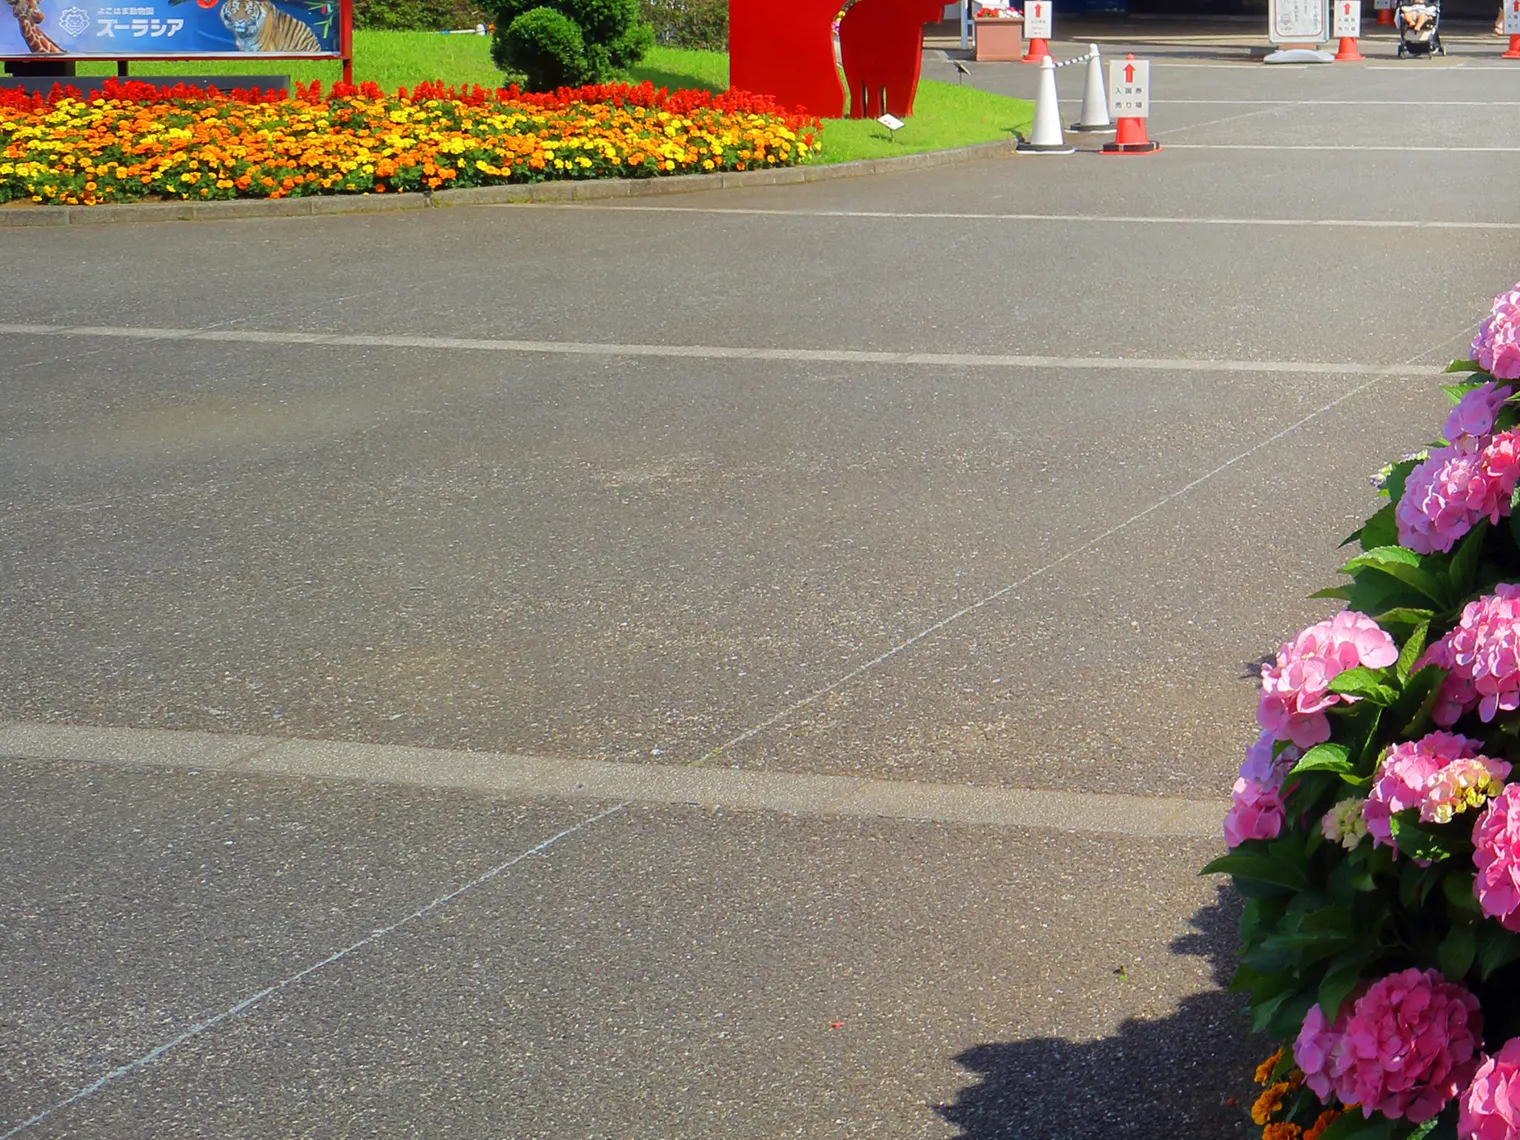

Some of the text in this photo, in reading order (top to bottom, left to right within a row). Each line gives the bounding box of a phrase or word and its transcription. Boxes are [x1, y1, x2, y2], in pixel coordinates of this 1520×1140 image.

[96, 19, 184, 37] ズーラシア
